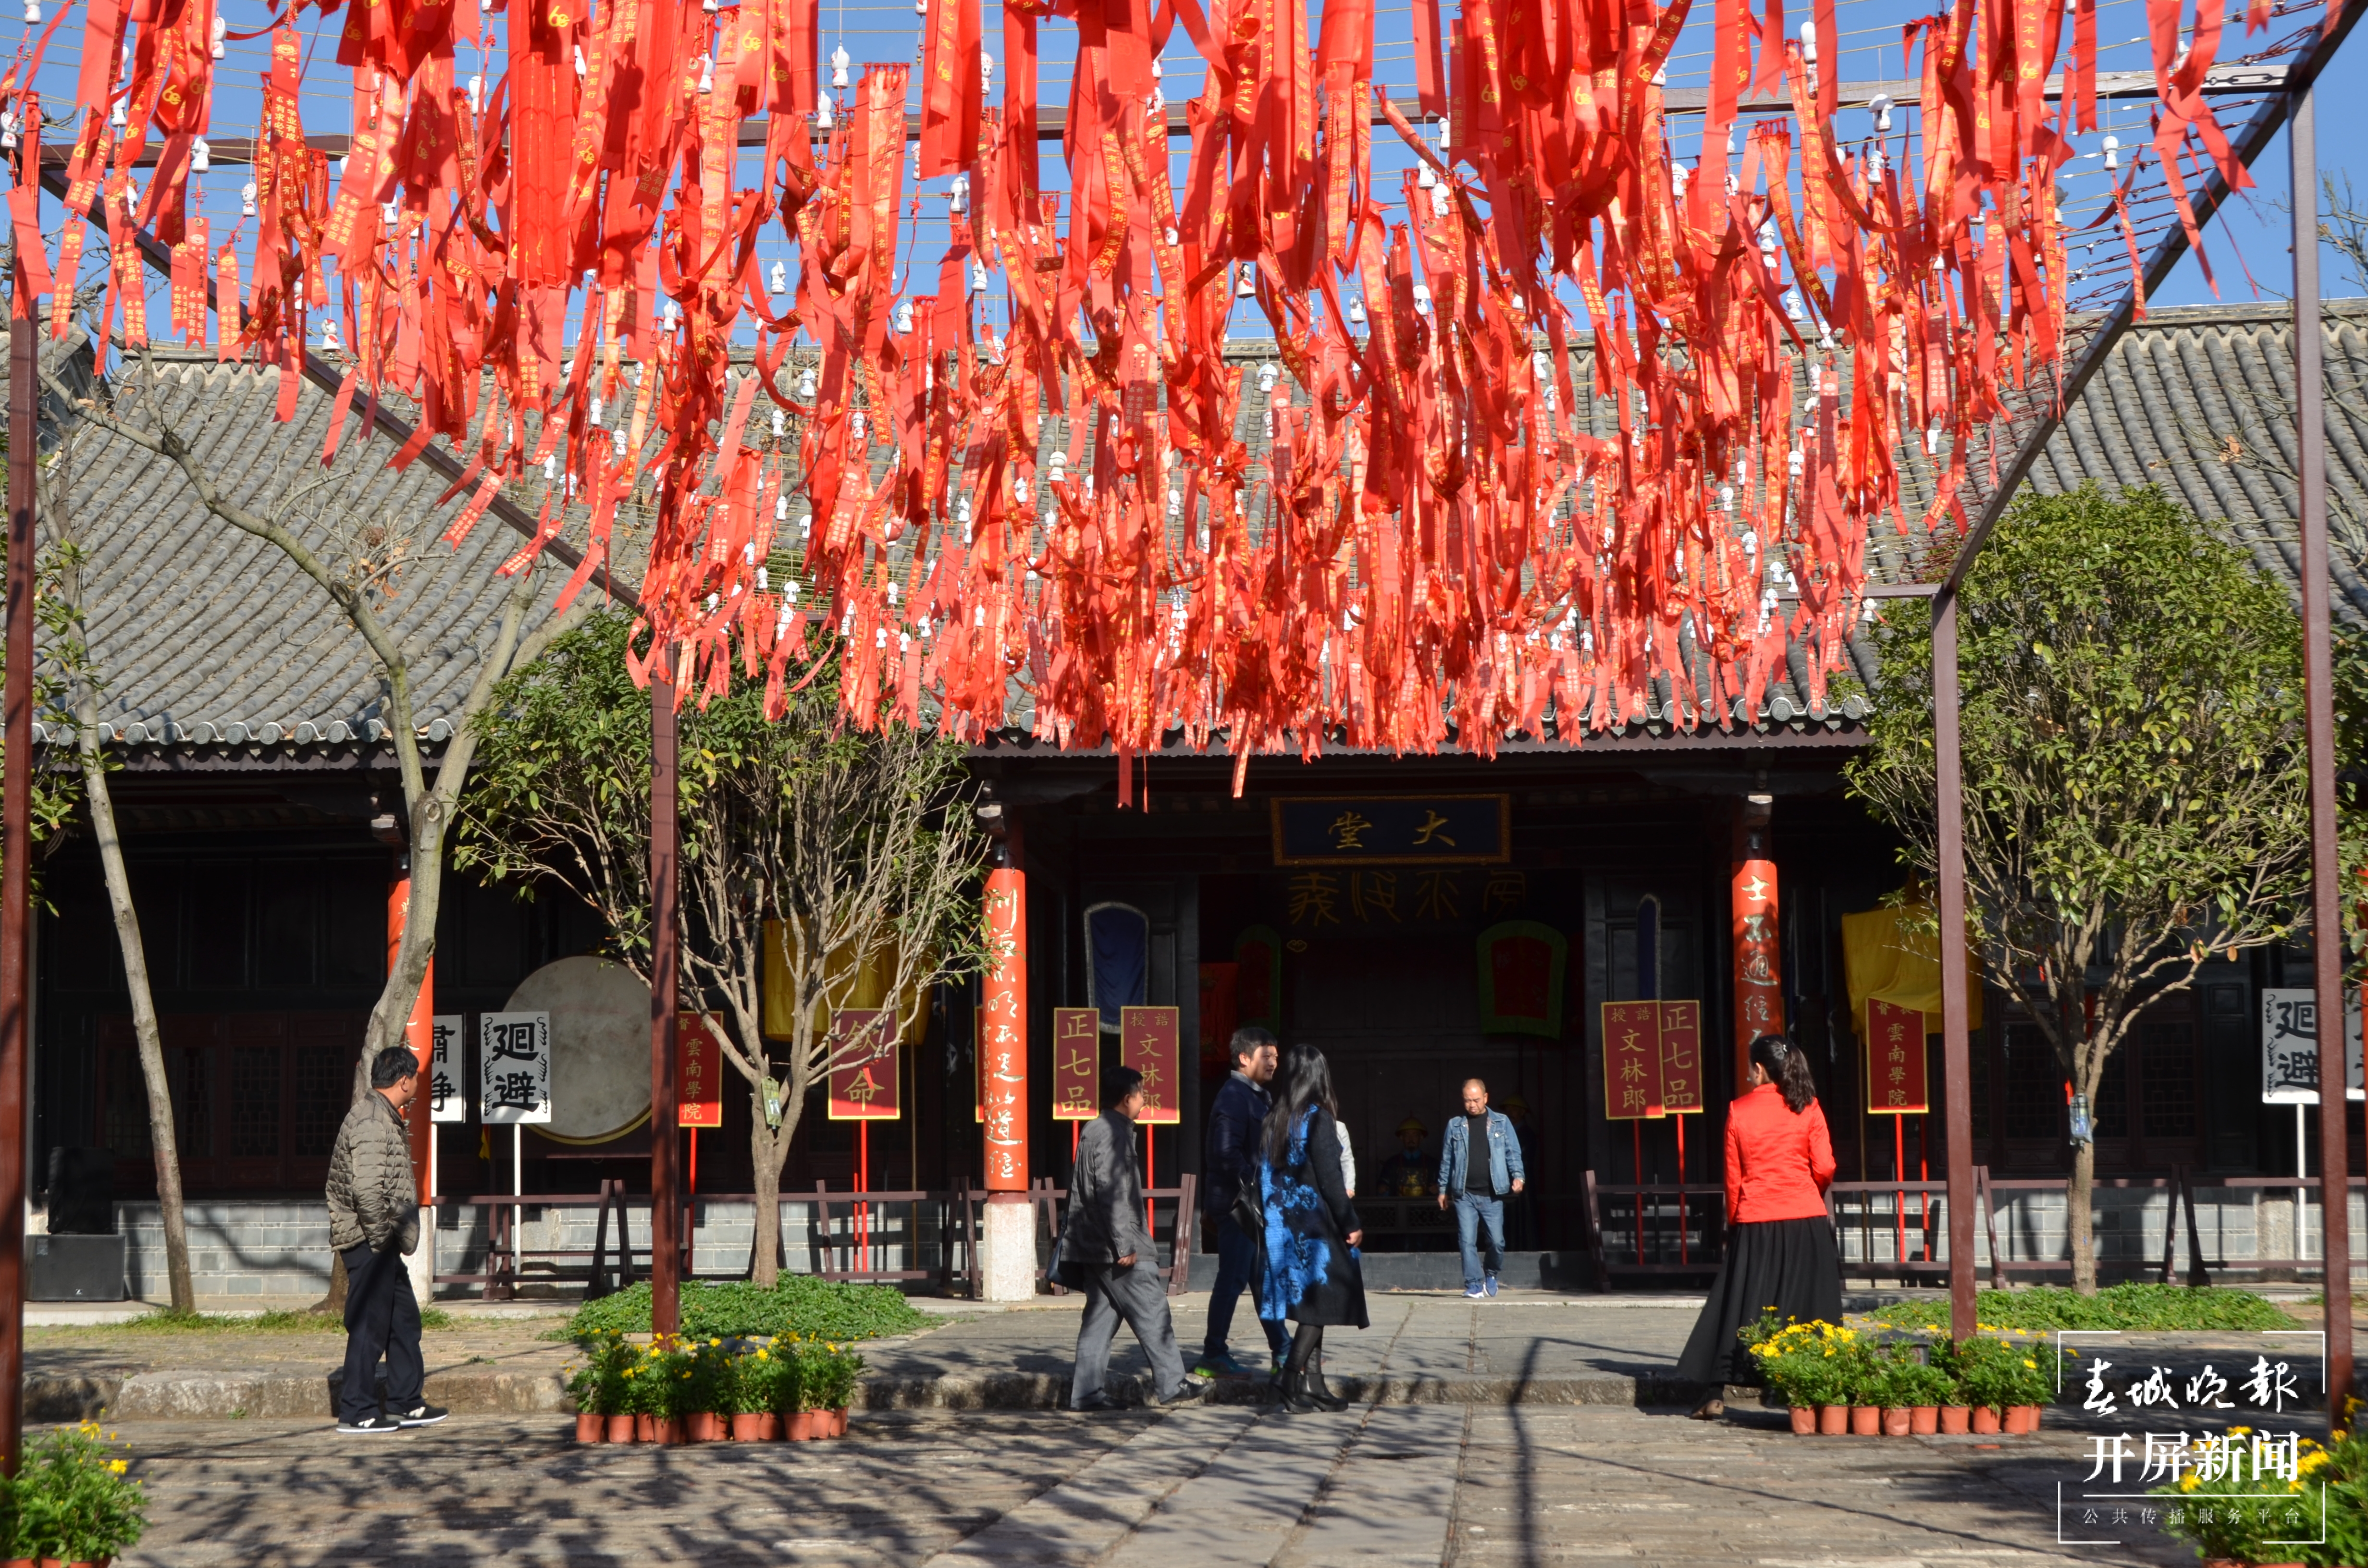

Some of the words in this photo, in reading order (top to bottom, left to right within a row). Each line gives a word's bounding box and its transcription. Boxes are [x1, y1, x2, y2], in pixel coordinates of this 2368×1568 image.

[684, 1038, 703, 1121] 雲南學院
[1060, 1014, 1094, 1114] 正七品
[1137, 1034, 1163, 1118] 文林郎
[1619, 1029, 1648, 1112] 文林郎
[1661, 1006, 1694, 1106] 正七品
[1887, 1022, 1908, 1106] 雲南學院
